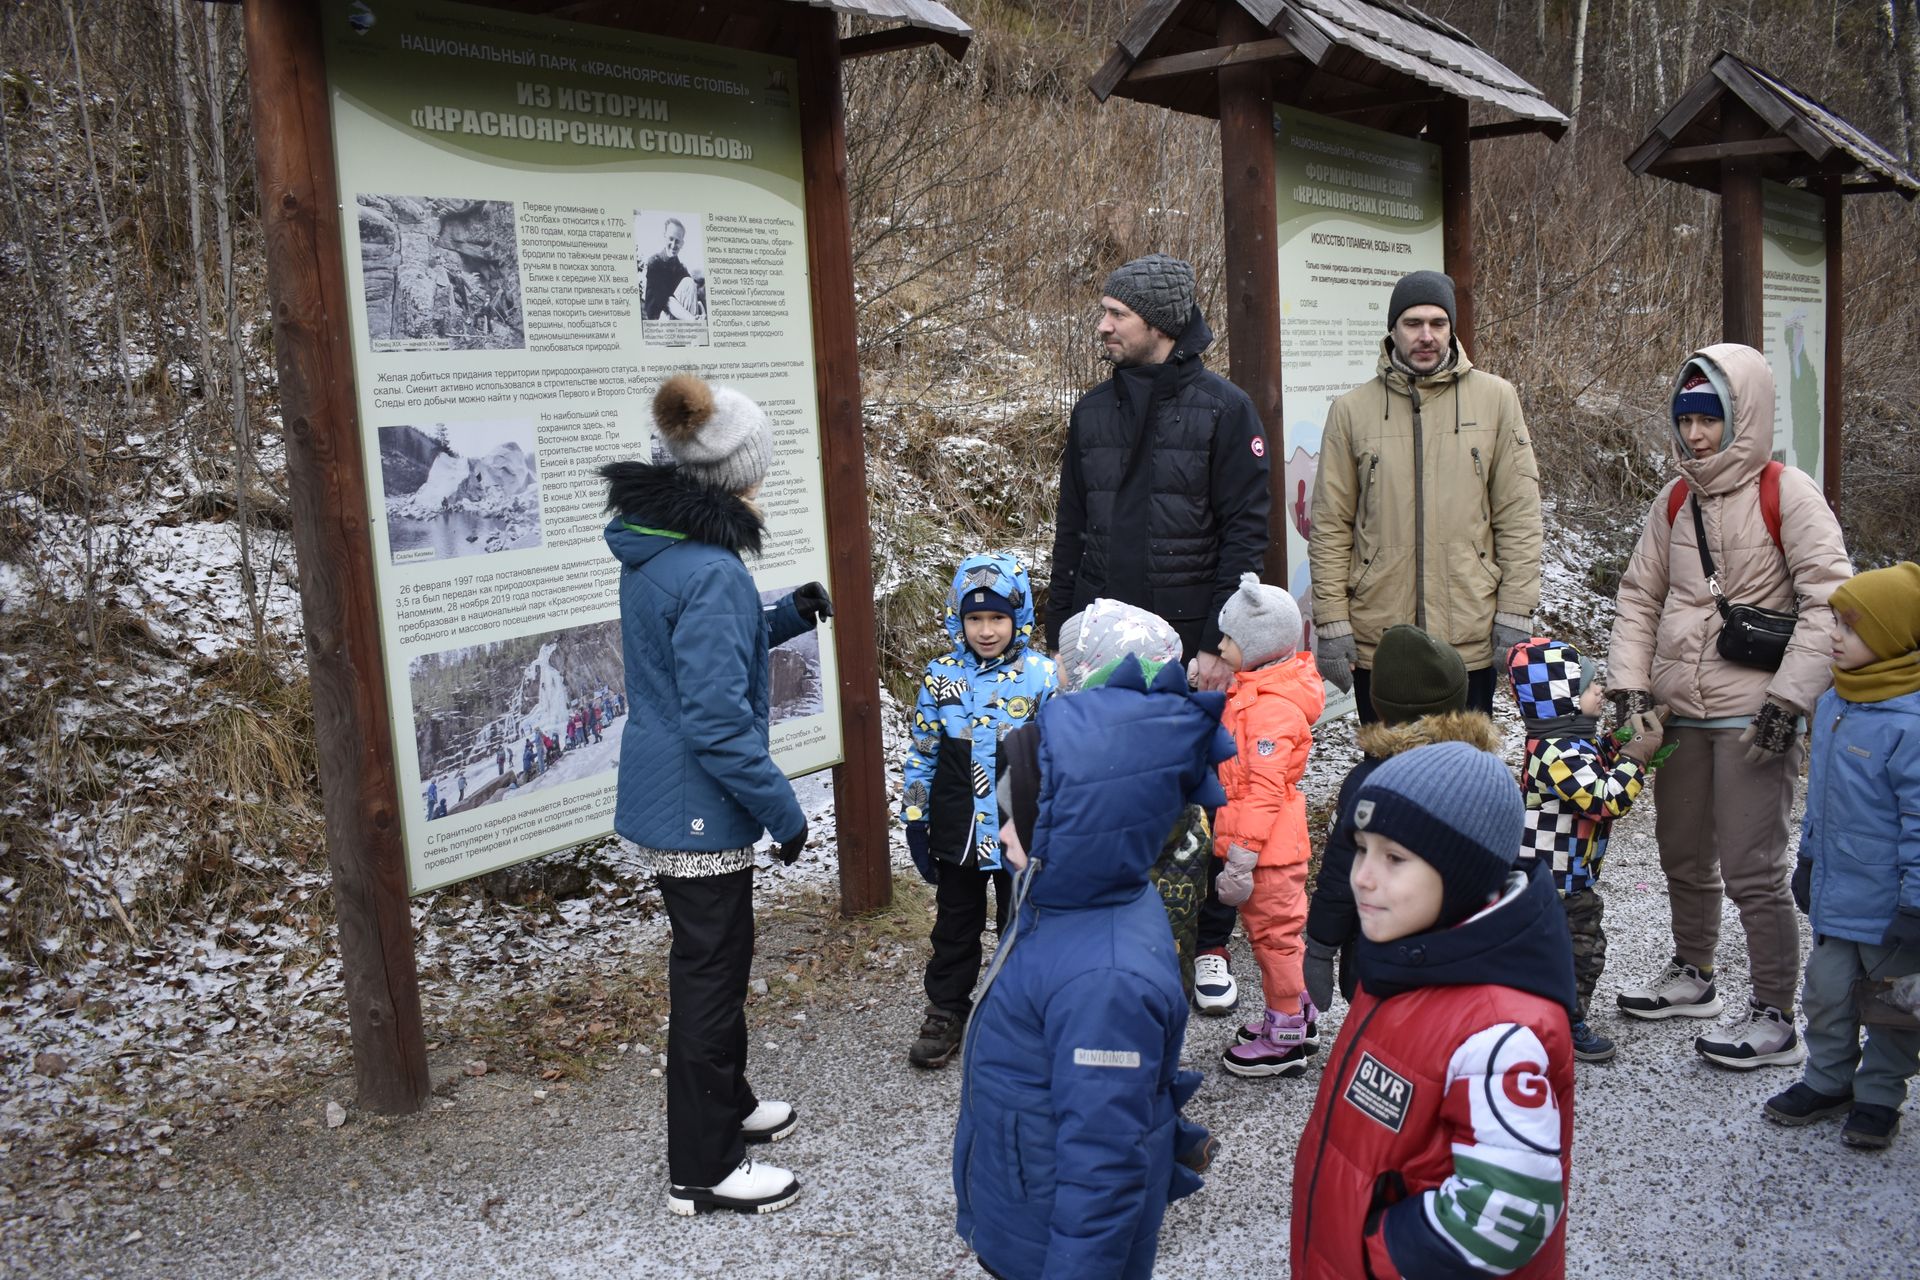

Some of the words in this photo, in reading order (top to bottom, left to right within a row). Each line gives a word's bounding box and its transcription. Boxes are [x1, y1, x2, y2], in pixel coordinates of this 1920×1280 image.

[399, 28, 536, 69] НАЦИОНАЛЬНЫЙ
[539, 52, 578, 73] ПАРК
[580, 59, 691, 89] «КРАСНОЯРСКИЕ
[692, 75, 750, 97] СТОЛБЫ»
[515, 80, 552, 110] ИЗ
[556, 85, 670, 123] ИСТОРИИ
[408, 101, 636, 150] «КРАСНОЯРСКИХ
[638, 126, 753, 163] СТОЛБОВ»
[1306, 162, 1387, 193] ФОРМИРОВАНИЕ
[522, 201, 552, 212] Первое
[553, 205, 598, 214] упоминание
[1293, 185, 1377, 214] «КРАСНОЯРСКИХ
[1379, 200, 1423, 220] СТОЛБОВ»
[519, 213, 560, 223] «Столбах»
[562, 217, 599, 225] относится
[606, 218, 627, 227] 1770-
[520, 225, 539, 234] 1780
[540, 228, 565, 236] годам,
[567, 229, 587, 237] когда
[588, 230, 625, 239] старатели
[520, 238, 608, 248] золотопромышленники
[1311, 232, 1345, 247] ИСКУССТВО
[521, 249, 555, 259] бродили
[568, 251, 601, 260] таёжным
[602, 253, 628, 262] речкам
[522, 262, 551, 271] ручьям
[528, 273, 554, 281] Ближе
[561, 275, 596, 284] середине
[525, 296, 554, 306] людей,
[555, 298, 586, 307] которые
[610, 297, 632, 307] тайгу,
[573, 287, 615, 295] привлекать
[622, 286, 638, 294] себе
[527, 321, 566, 330] вершины,
[567, 320, 611, 328] пообщаться
[552, 310, 587, 318] покорить
[528, 332, 609, 341] единомышленниками
[529, 343, 584, 352] полюбоваться
[585, 342, 621, 352] природой.
[395, 596, 410, 607] 3,5
[422, 593, 440, 602] был
[442, 587, 477, 600] передан
[494, 574, 564, 592] природоохранные
[565, 571, 588, 580] земли
[412, 579, 451, 594] февраля
[453, 574, 474, 585] 1997
[475, 573, 494, 582] года
[495, 564, 560, 579] постановлением
[396, 606, 445, 619] Напомним,
[459, 598, 489, 609] ноября
[490, 593, 511, 604] 2019
[512, 592, 530, 601] года
[531, 582, 593, 598] постановлением
[398, 615, 459, 633] преобразован
[467, 602, 527, 620] национальный
[528, 600, 546, 610] парк
[548, 591, 603, 607] «Красноярские
[399, 629, 449, 644] свободного
[458, 620, 500, 634] массового
[502, 612, 546, 626] посещения
[547, 608, 568, 618] части
[435, 823, 482, 843] Гранитного
[483, 813, 516, 828] карьера
[517, 801, 561, 819] начинается
[562, 787, 602, 806] Восточный
[423, 844, 448, 858] очень
[449, 831, 493, 850] популярен
[501, 819, 536, 836] туристов
[544, 804, 593, 822] спортсменов.
[424, 852, 463, 870] проводят
[465, 838, 511, 858] тренировки
[519, 820, 573, 841] соревнования
[1360, 1060, 1405, 1103] GLVR
